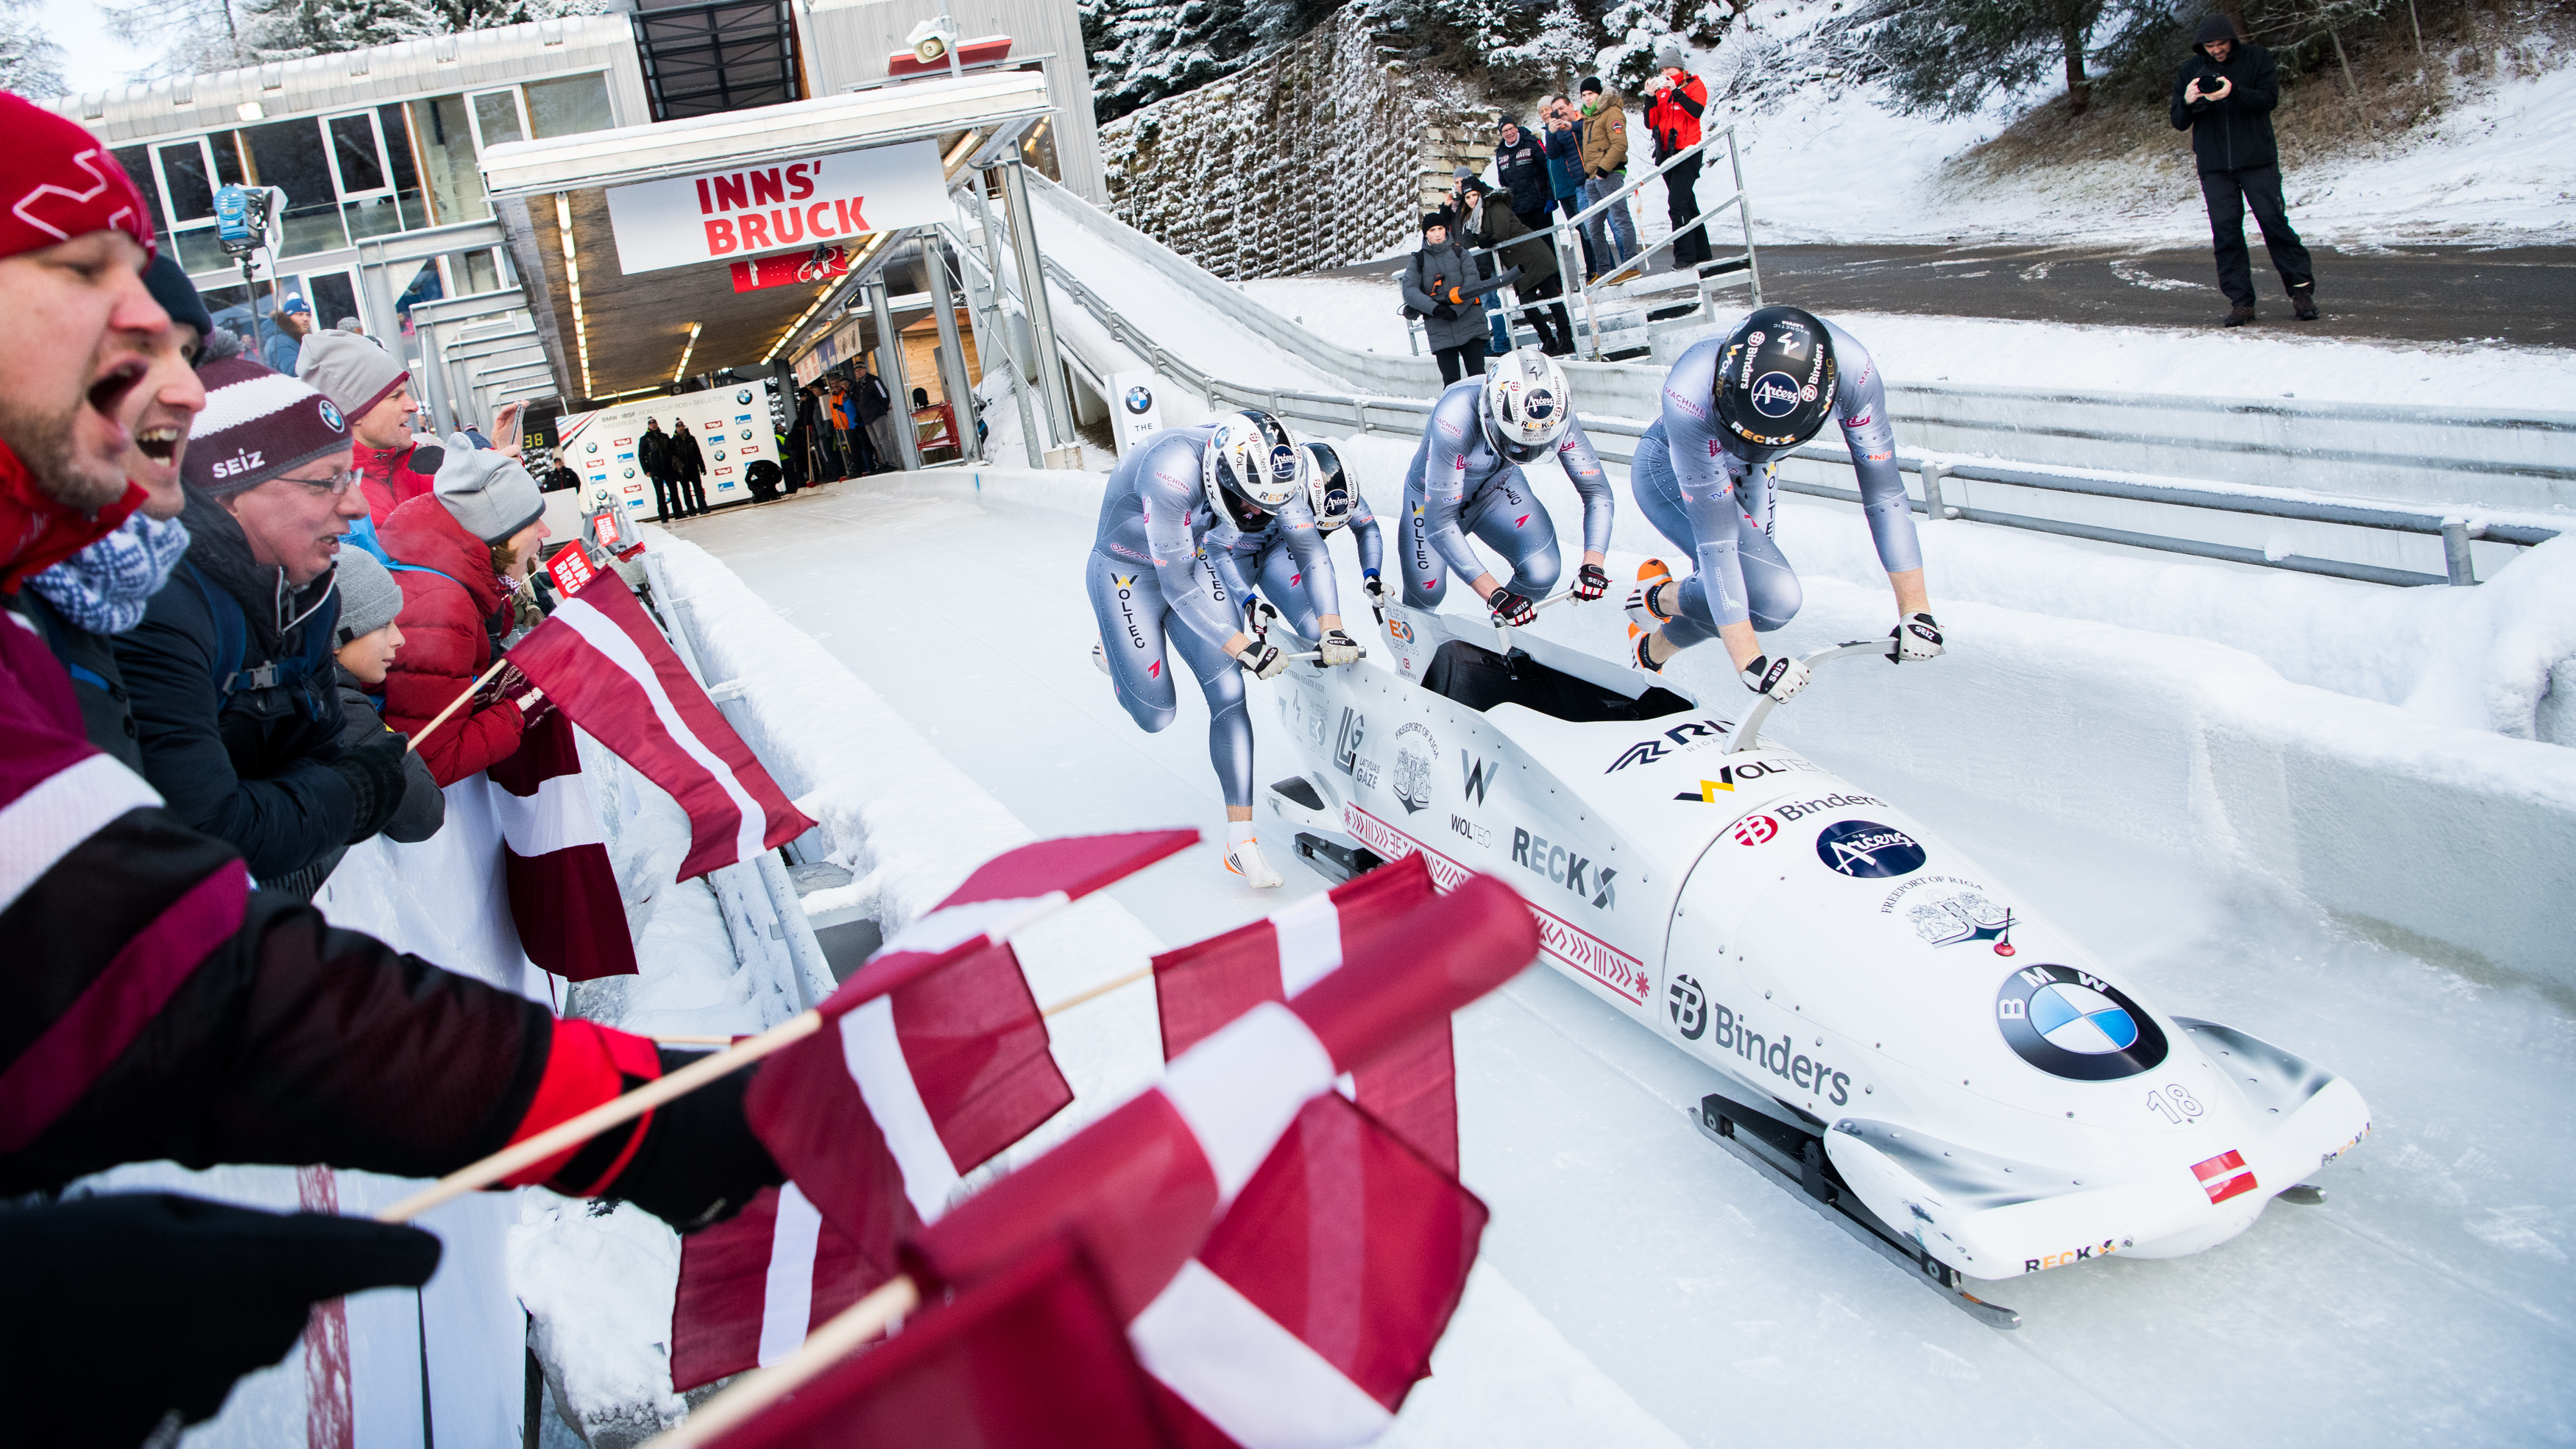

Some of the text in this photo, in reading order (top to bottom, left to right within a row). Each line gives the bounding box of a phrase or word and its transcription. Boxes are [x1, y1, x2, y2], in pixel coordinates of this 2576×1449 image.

[704, 196, 871, 256] BRUCK
[1741, 347, 1758, 389] Binders
[1808, 343, 1824, 385] Binders
[602, 414, 618, 422] BMW
[637, 407, 660, 417] WORLD
[662, 404, 673, 413] CUP
[674, 401, 688, 409] BOB
[693, 395, 725, 406] SKELETON
[1664, 386, 1706, 416] MACHINE
[1135, 422, 1153, 432] THE
[1435, 417, 1463, 436] MACHINE
[1253, 443, 1268, 474] Binders
[1155, 471, 1191, 492] MACHINE
[1347, 472, 1355, 500] Binders
[554, 561, 581, 594] BRU
[565, 551, 592, 587] INN
[1110, 573, 1145, 648] WOLTEC
[1393, 638, 1419, 656] SERVISS
[1399, 668, 1417, 680] BASTIONS
[1395, 722, 1440, 760] FREEPORT OF RIGA
[1686, 737, 1721, 753] RIGA
[1359, 757, 1381, 774] LATVIJAS
[1673, 759, 1834, 804] WOLTEC
[1774, 793, 1889, 821] Binders
[1451, 813, 1492, 849] WOLTEC
[1881, 877, 1927, 914] FREEPORT
[1947, 876, 1984, 890] RIGA
[1999, 966, 2110, 1020] BMW
[1714, 1002, 1850, 1107] Binders
[2145, 1083, 2204, 1124] 18
